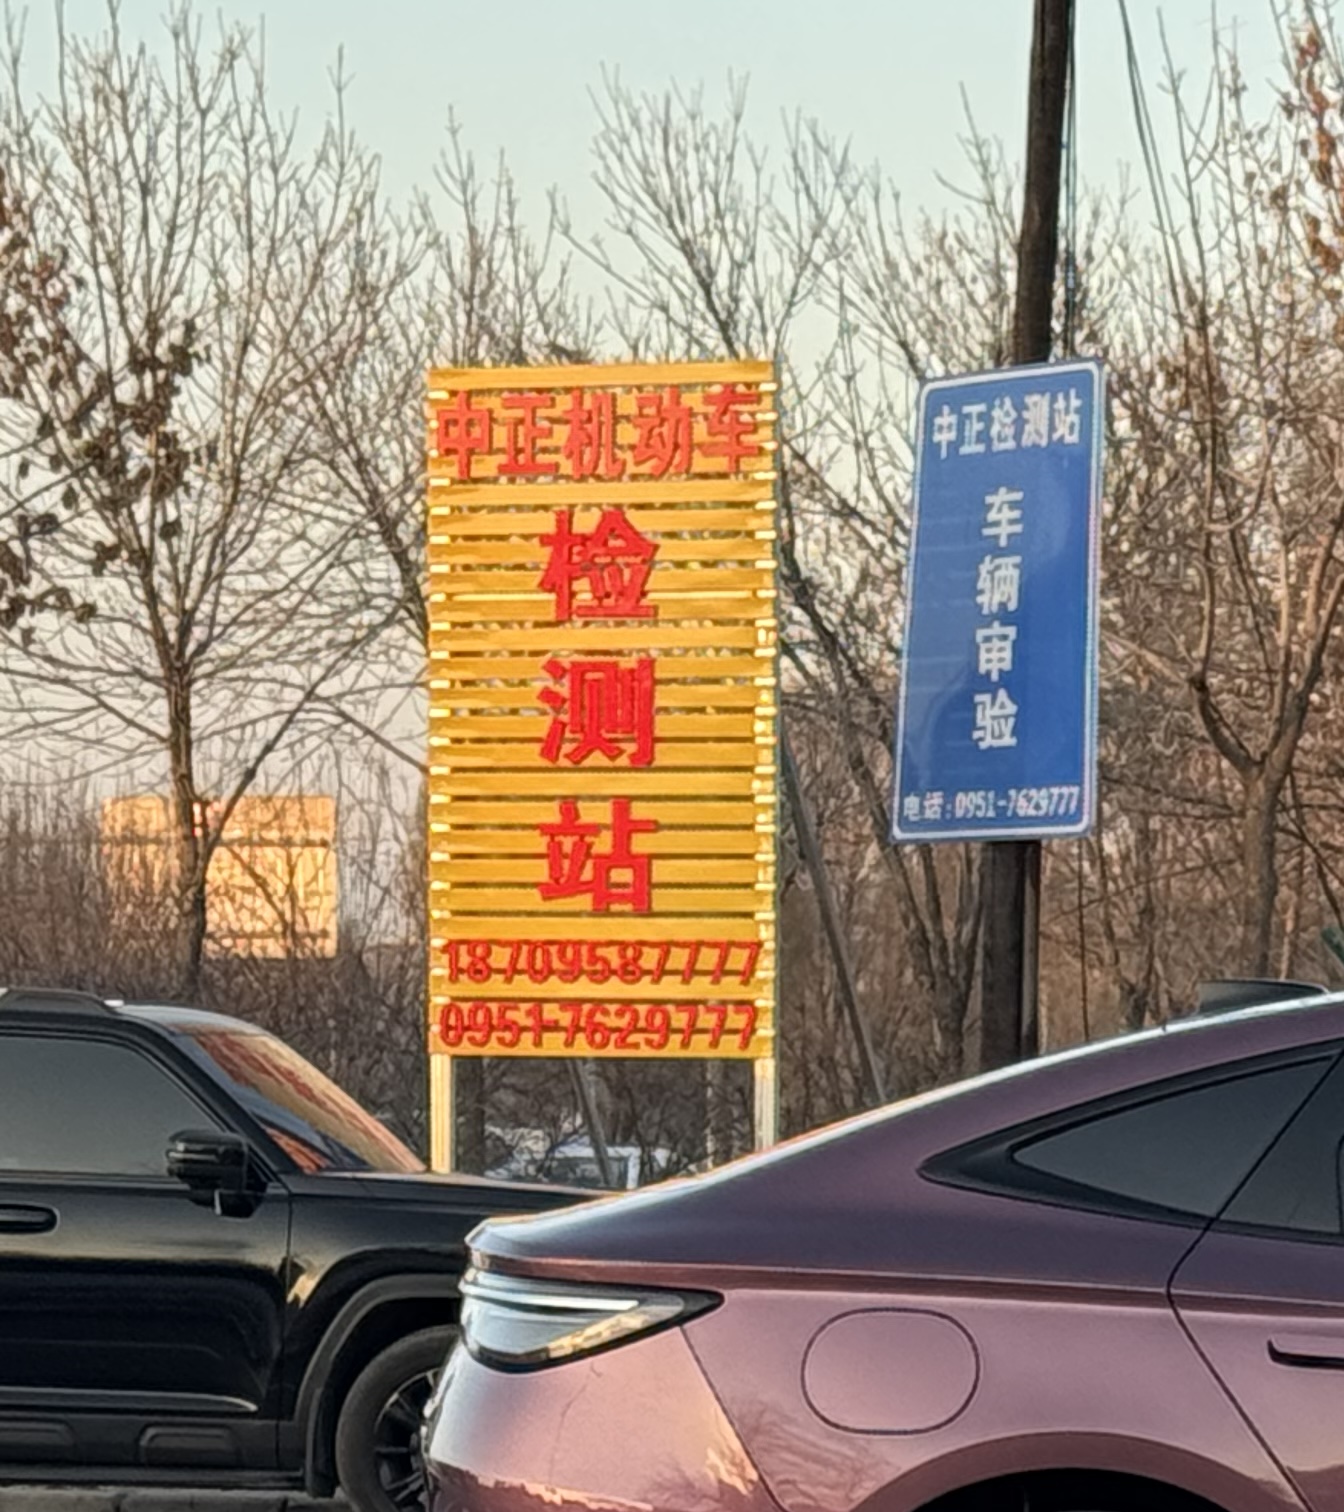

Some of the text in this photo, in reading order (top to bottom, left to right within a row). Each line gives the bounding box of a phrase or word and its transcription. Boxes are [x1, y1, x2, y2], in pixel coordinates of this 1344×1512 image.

[437, 382, 759, 479] 中正机动车
[933, 388, 1082, 460] 中正检测站
[972, 487, 1024, 749] 车辆审验
[537, 508, 660, 914] 检测站
[442, 940, 760, 985] 18709587777
[440, 1001, 758, 1050] 0951-7629777
